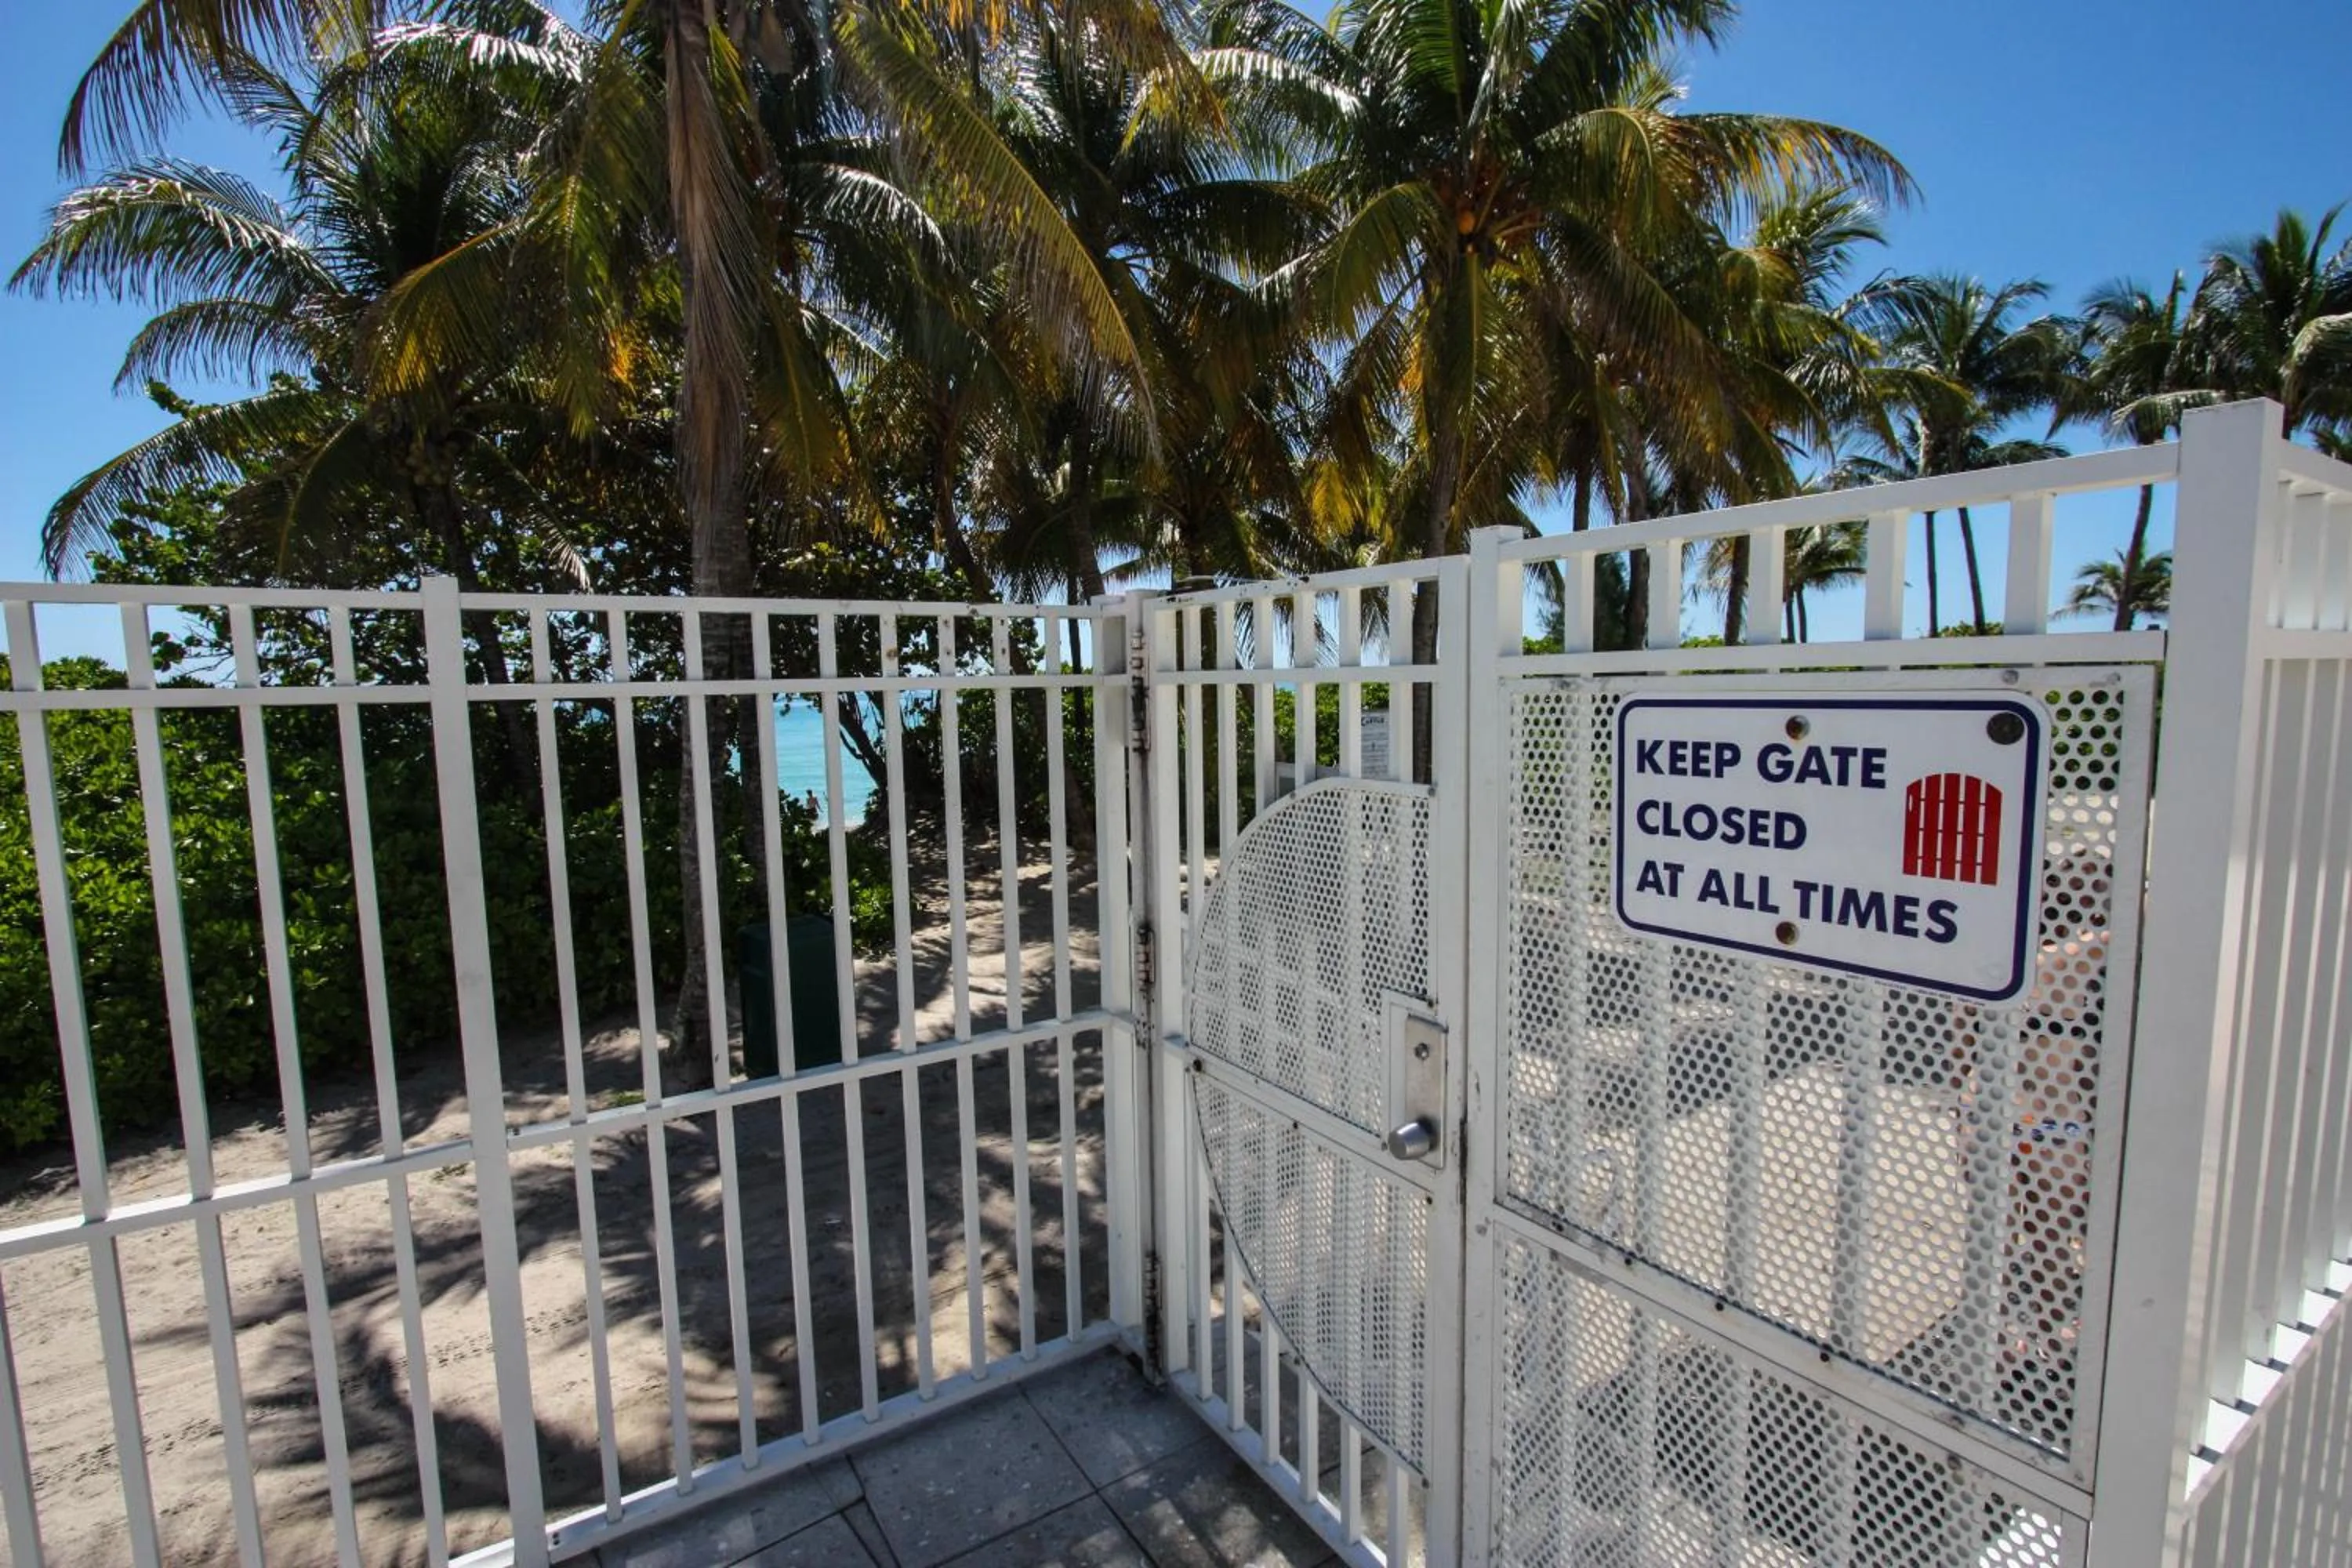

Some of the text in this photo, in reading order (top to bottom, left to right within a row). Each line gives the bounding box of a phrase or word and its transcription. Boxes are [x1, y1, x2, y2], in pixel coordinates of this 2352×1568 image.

[1636, 739, 1887, 789] KEEP GATE
[1636, 799, 1807, 851] CLOSED
[1636, 859, 1958, 944] AT ALL TIMES
